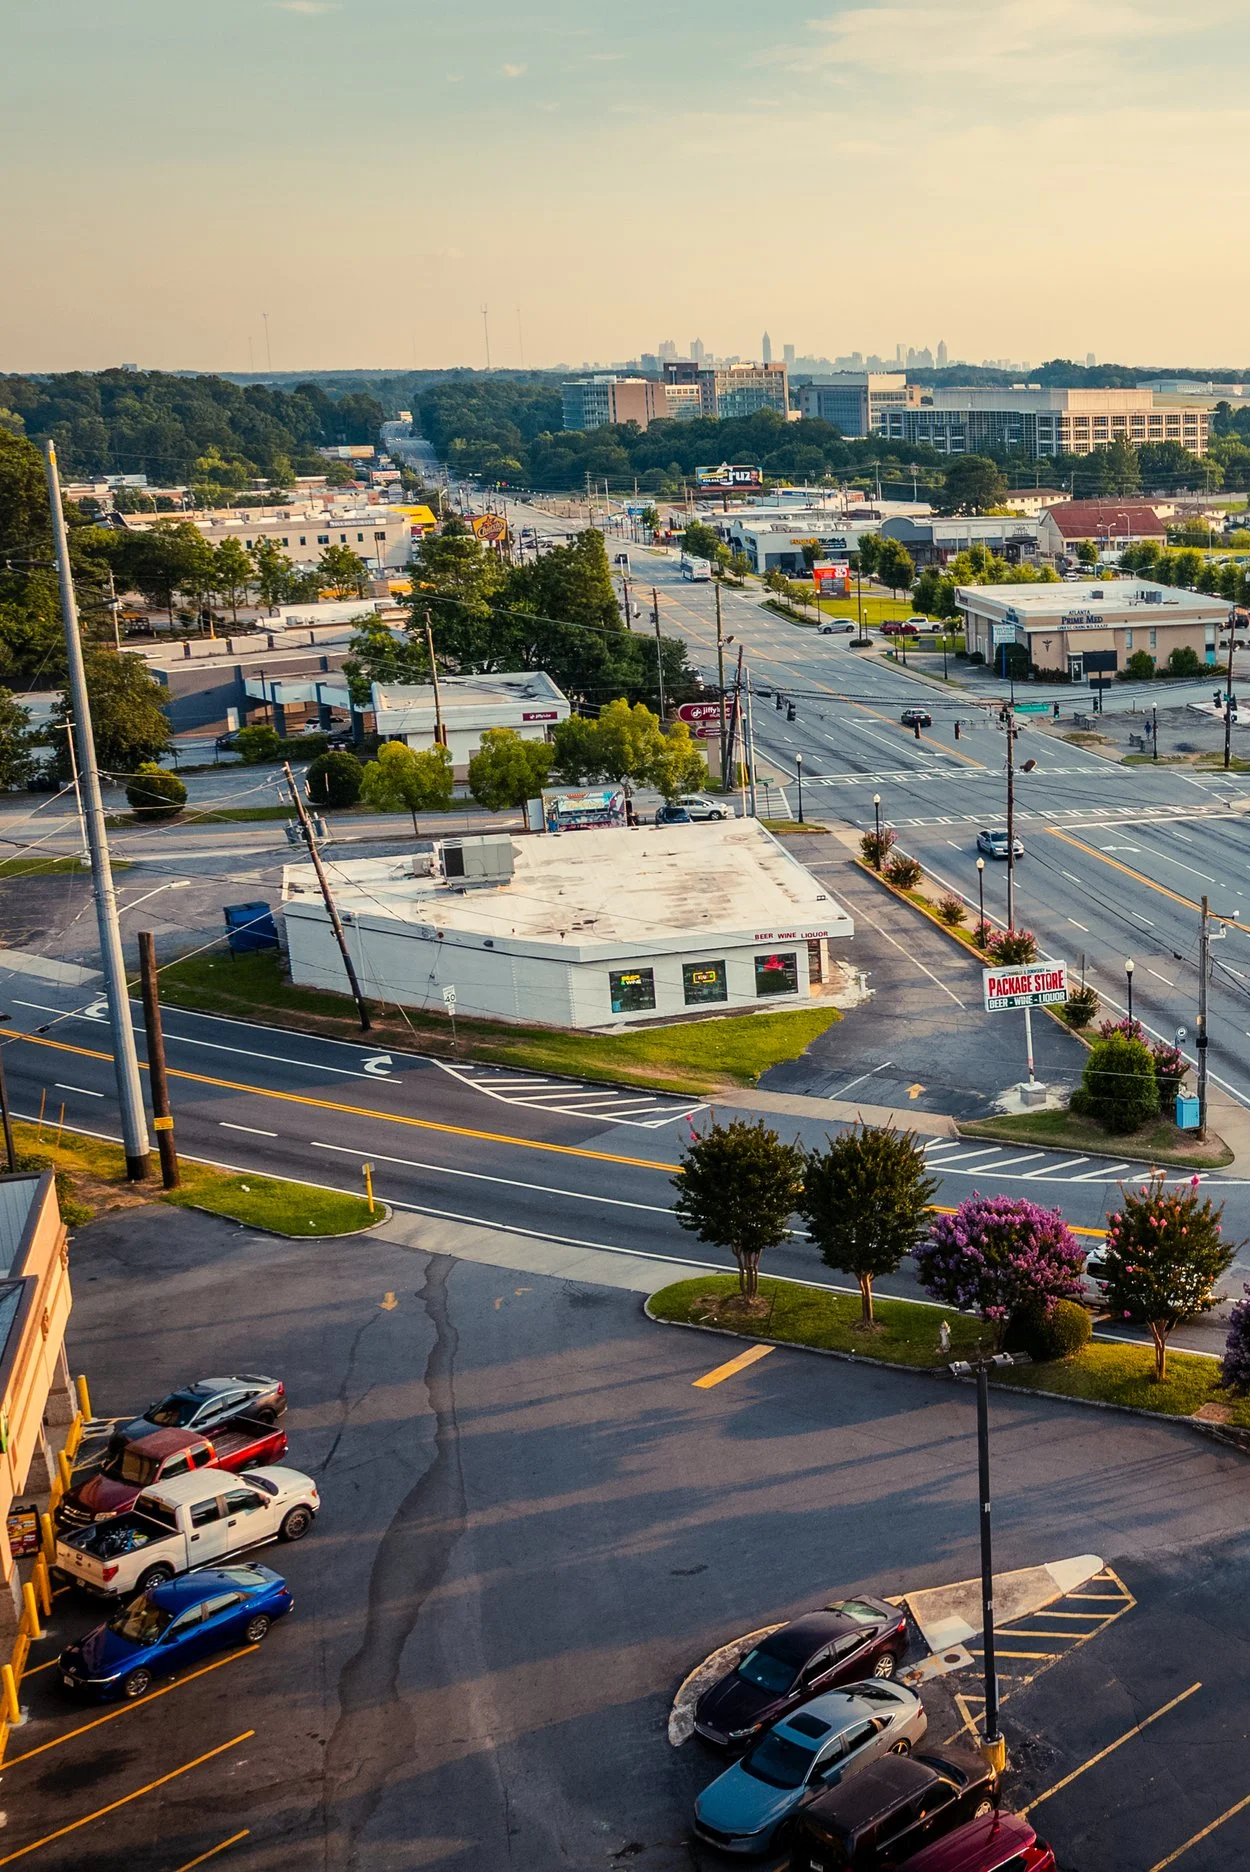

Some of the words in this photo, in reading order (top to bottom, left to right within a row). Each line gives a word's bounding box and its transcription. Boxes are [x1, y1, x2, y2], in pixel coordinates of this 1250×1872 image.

[754, 933, 774, 941] BEER
[801, 931, 829, 939] LIQUOR
[988, 974, 1033, 998] PACKAGE
[1034, 969, 1065, 992] STORE
[989, 998, 1008, 1009] BEER
[1014, 994, 1034, 1006] WINE
[1038, 991, 1066, 1003] LIQUOR
